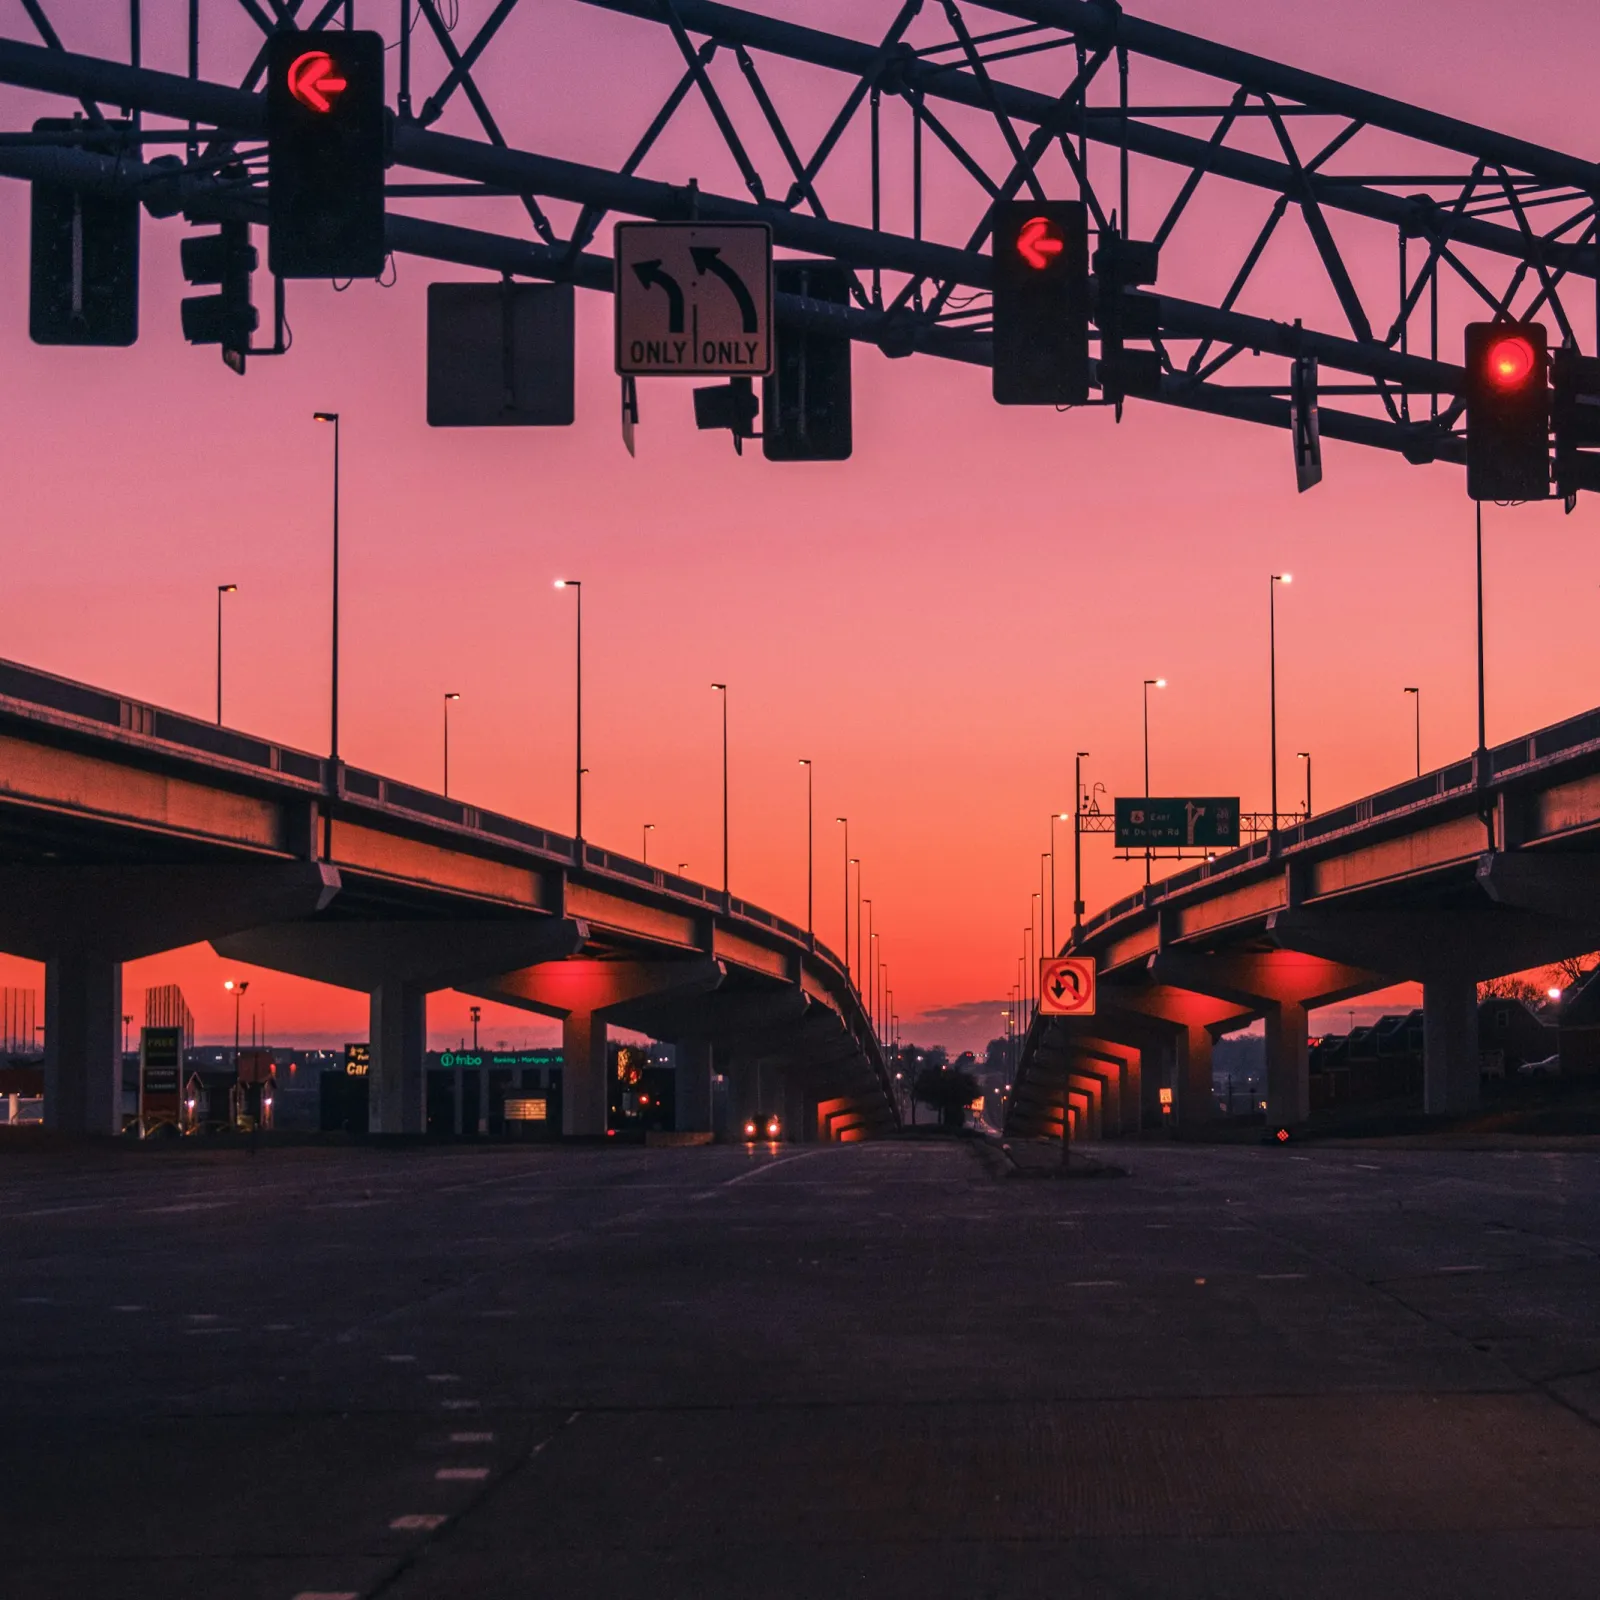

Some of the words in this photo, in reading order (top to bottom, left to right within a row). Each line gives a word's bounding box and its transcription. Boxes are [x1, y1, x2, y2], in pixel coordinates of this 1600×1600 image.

[630, 340, 687, 364] ONLY
[702, 340, 759, 364] ONLY
[1121, 828, 1129, 836] W
[1167, 828, 1180, 836] Rd
[456, 1054, 483, 1066] fnbo
[346, 1061, 369, 1076] Car
